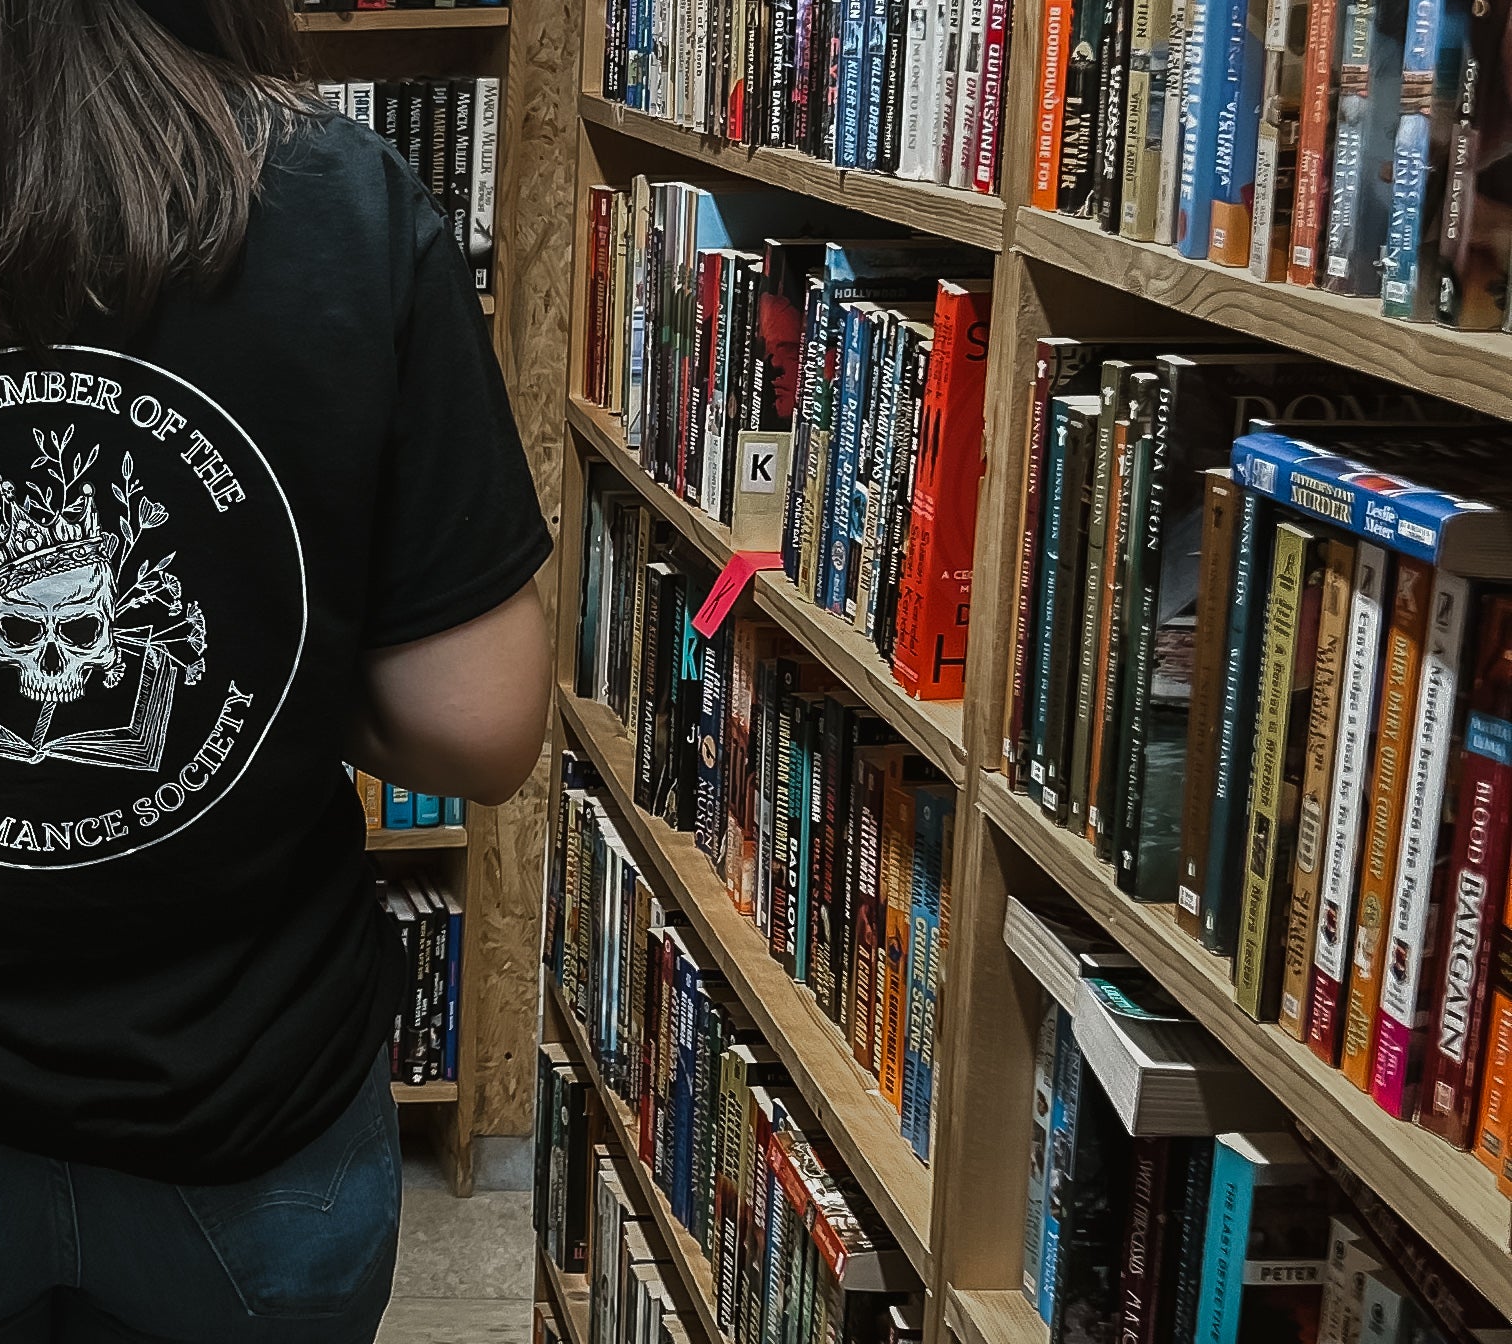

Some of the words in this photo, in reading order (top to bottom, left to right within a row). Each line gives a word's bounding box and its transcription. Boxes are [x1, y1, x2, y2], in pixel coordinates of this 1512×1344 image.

[846, 60, 859, 104] KILLER
[1042, 7, 1061, 109] BLOODHOUND
[843, 107, 857, 161] DREAMS
[977, 42, 1002, 167] QUICKSAND
[1041, 113, 1053, 131] TO
[1037, 163, 1049, 190] FOR
[1039, 135, 1051, 160] DIE
[130, 395, 187, 441] OF
[180, 429, 246, 513] THE
[1152, 388, 1170, 473] DONNA
[751, 453, 772, 481] K
[1147, 483, 1163, 551] LEON
[132, 680, 254, 826] SOCIETY
[1376, 746, 1397, 790] QUITE
[1368, 795, 1391, 881] CONTRARY
[1466, 781, 1492, 864] BLOOD
[912, 917, 926, 986] CRIME
[1438, 871, 1486, 1063] BARGAIN
[909, 988, 924, 1053] SCENE
[1223, 1181, 1236, 1210] THE
[1219, 1216, 1234, 1256] LAST
[1209, 1258, 1229, 1343] DETECTIVE
